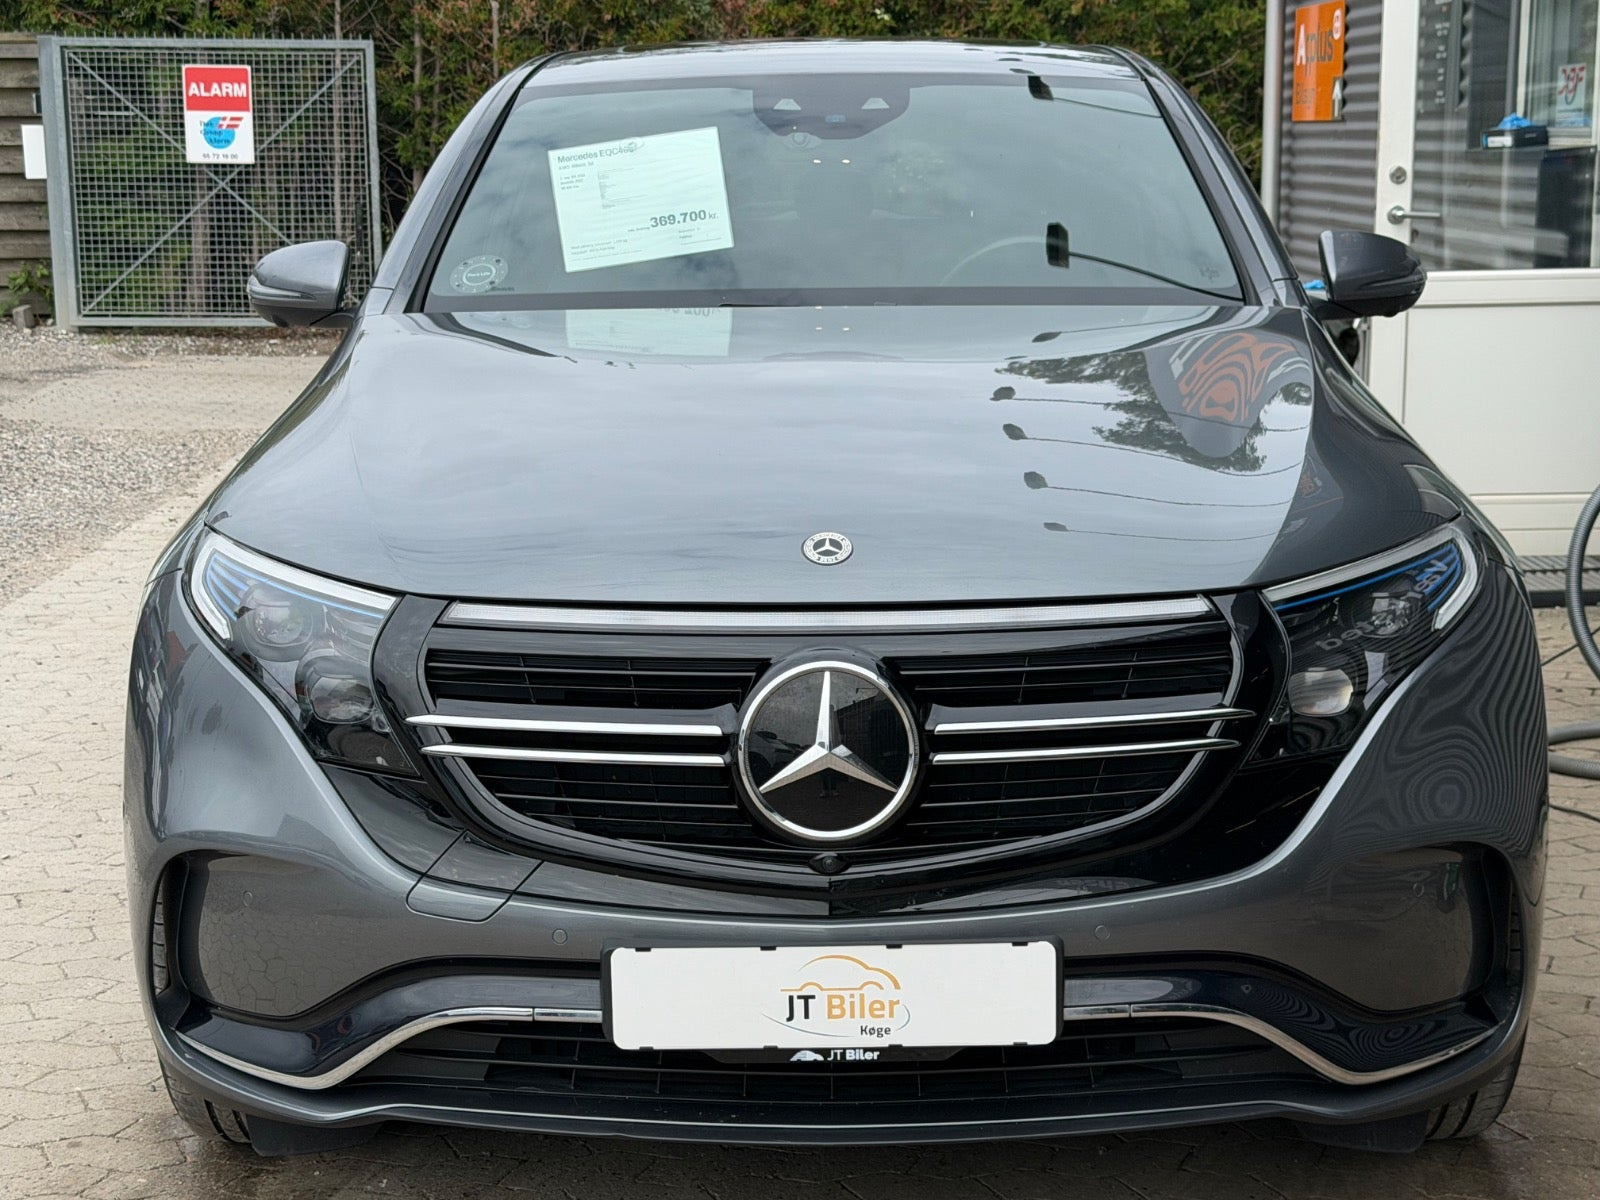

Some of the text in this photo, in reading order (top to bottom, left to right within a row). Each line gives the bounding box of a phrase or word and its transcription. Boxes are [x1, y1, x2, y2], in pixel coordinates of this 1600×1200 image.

[188, 82, 247, 98] ALARM
[557, 151, 598, 164] Mercedes
[650, 209, 719, 228] 369.700 kr.
[786, 993, 900, 1022] JT Biler
[860, 1025, 891, 1038] Køge
[827, 1048, 880, 1061] JT Biler
